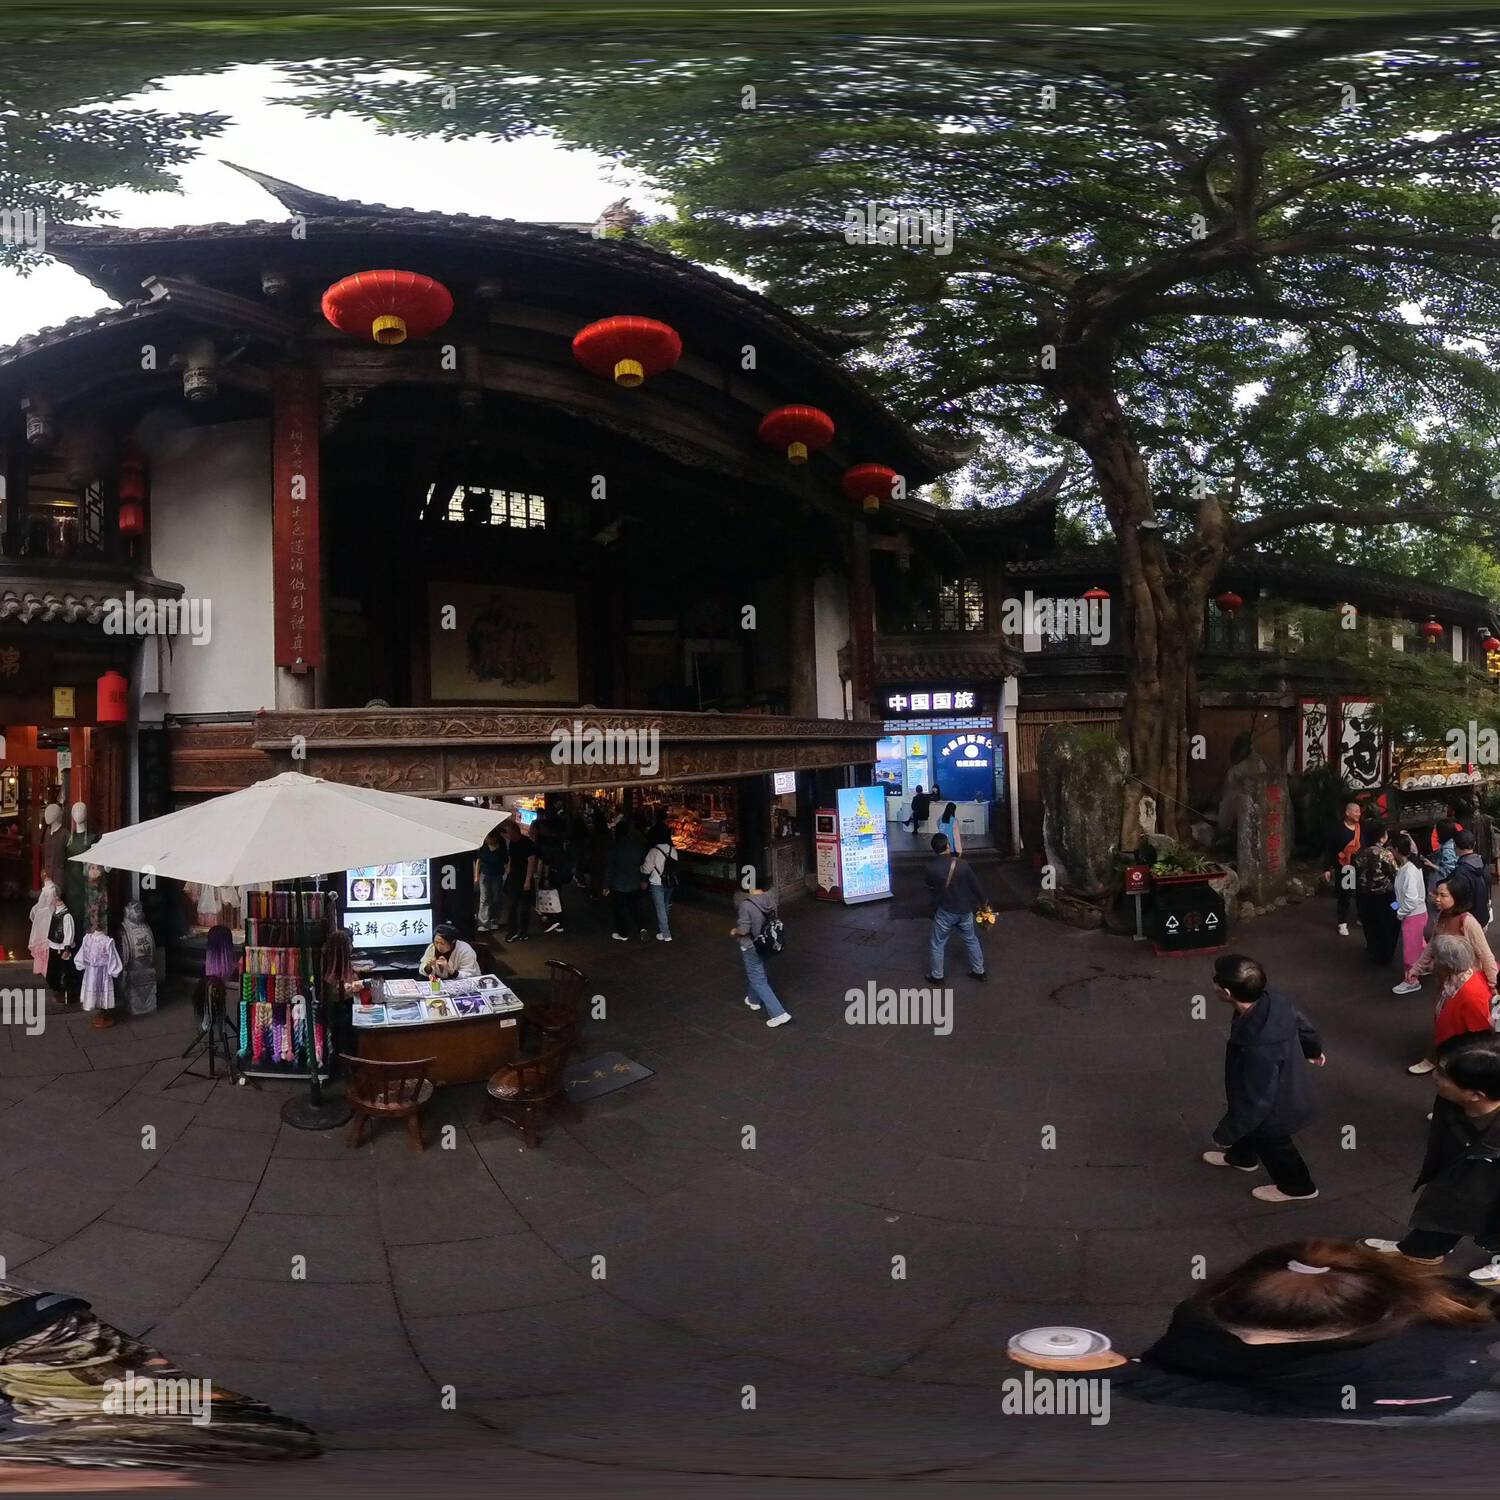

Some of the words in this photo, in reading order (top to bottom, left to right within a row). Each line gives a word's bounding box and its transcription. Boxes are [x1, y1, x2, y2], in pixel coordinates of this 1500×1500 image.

[888, 691, 975, 711] 中国国旅
[398, 918, 428, 937] 手绘
